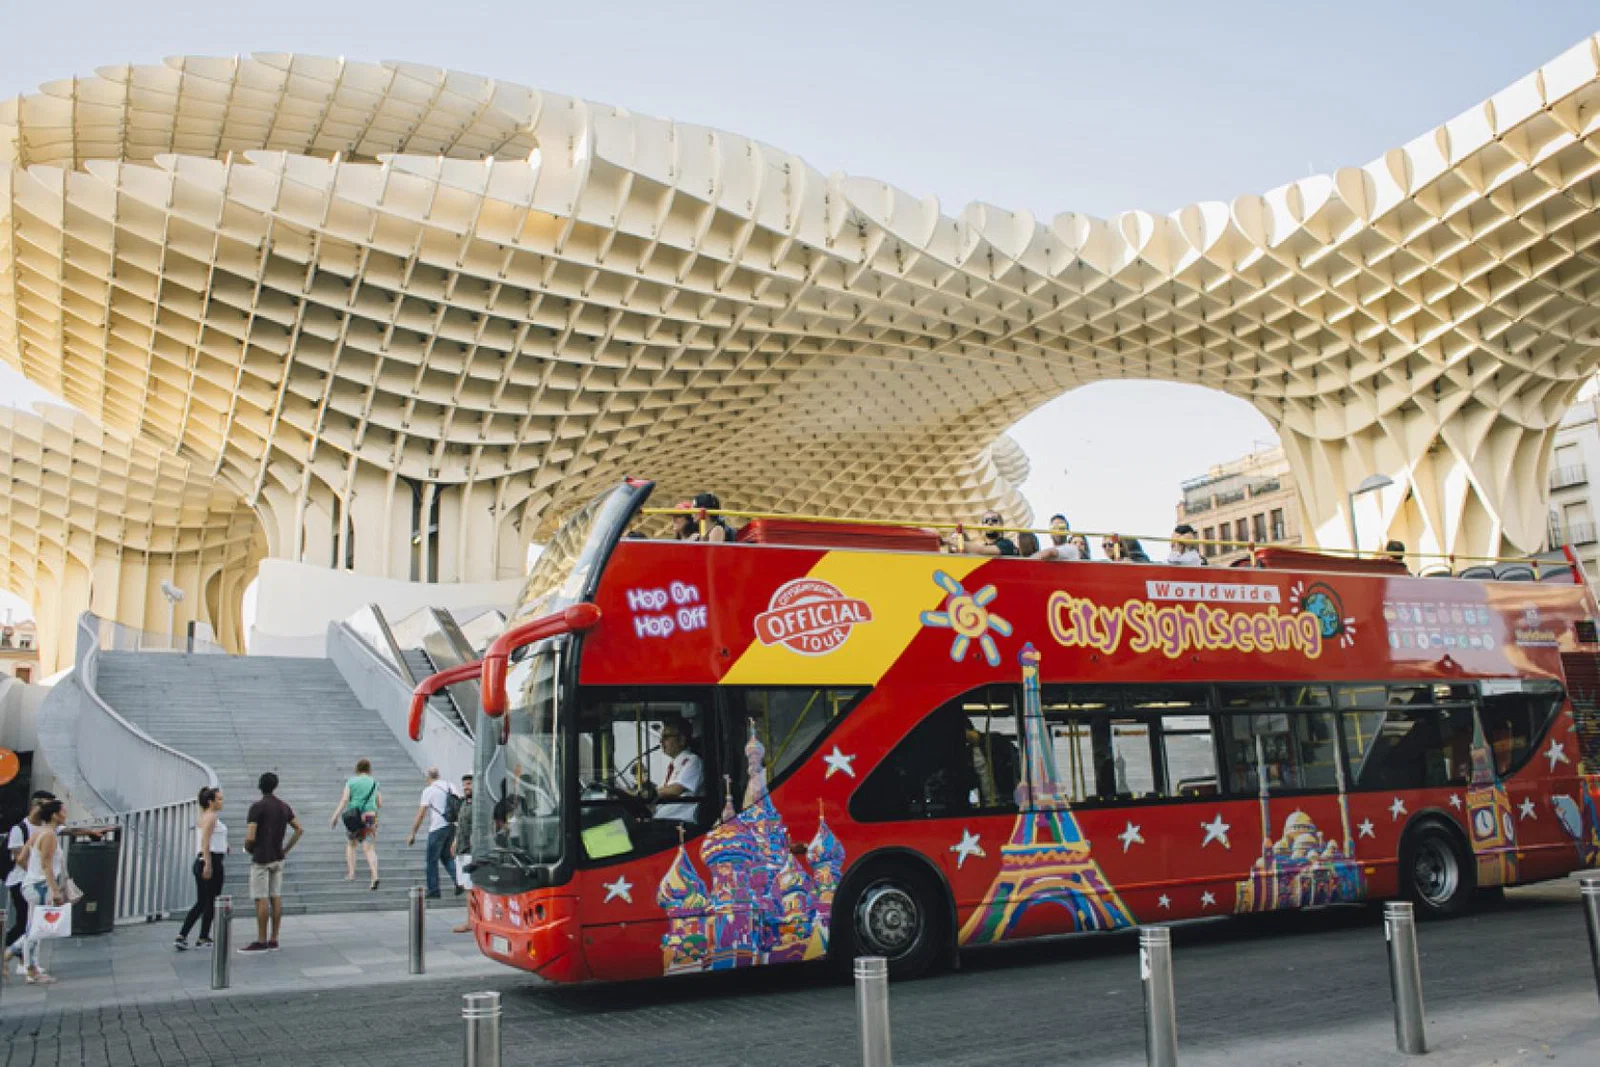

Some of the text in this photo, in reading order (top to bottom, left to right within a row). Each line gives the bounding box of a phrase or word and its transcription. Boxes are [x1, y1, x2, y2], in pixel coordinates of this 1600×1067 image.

[626, 580, 699, 612] Hop On
[1155, 582, 1273, 600] Worldwide
[633, 604, 707, 638] Hop Off
[768, 602, 867, 638] OFFICIAL
[802, 627, 846, 651] TOUR
